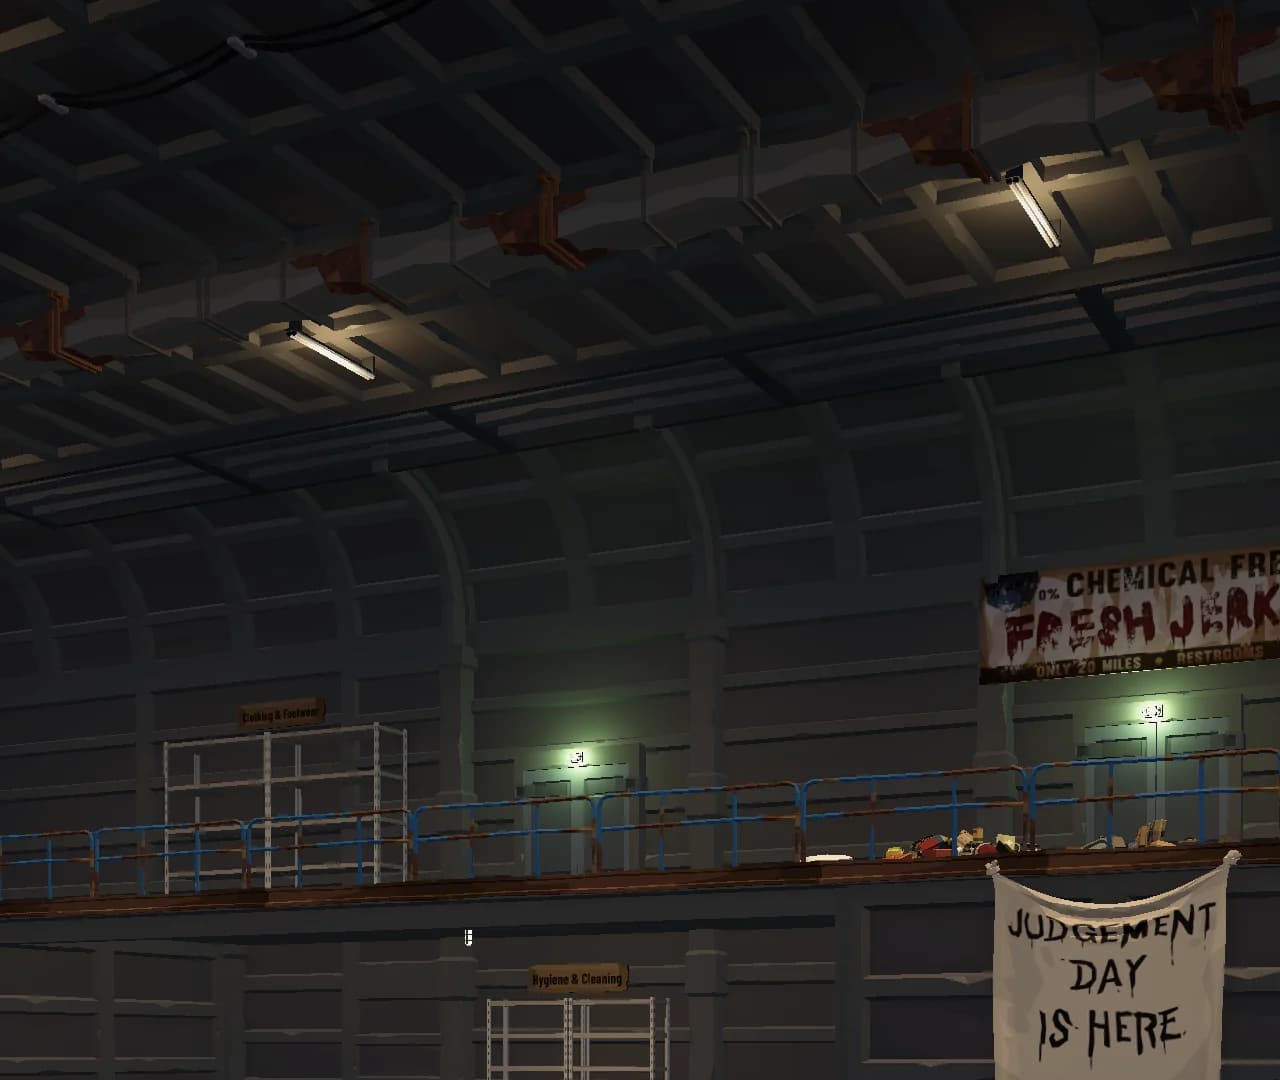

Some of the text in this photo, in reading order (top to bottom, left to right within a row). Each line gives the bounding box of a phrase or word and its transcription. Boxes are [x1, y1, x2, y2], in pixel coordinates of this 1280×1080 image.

[1067, 558, 1215, 597] CHEMICAL
[1004, 600, 1156, 656] FRESH
[1036, 663, 1070, 679] ONLY
[1077, 660, 1096, 674] 20
[1102, 656, 1143, 672] MILES
[1176, 645, 1264, 665] RESTROOMS
[1008, 902, 1216, 952] JUDGEMENT
[532, 972, 622, 987] Hygiene & Cleaning
[1069, 954, 1147, 997] DAY
[1038, 1007, 1183, 1062] IS HERE
